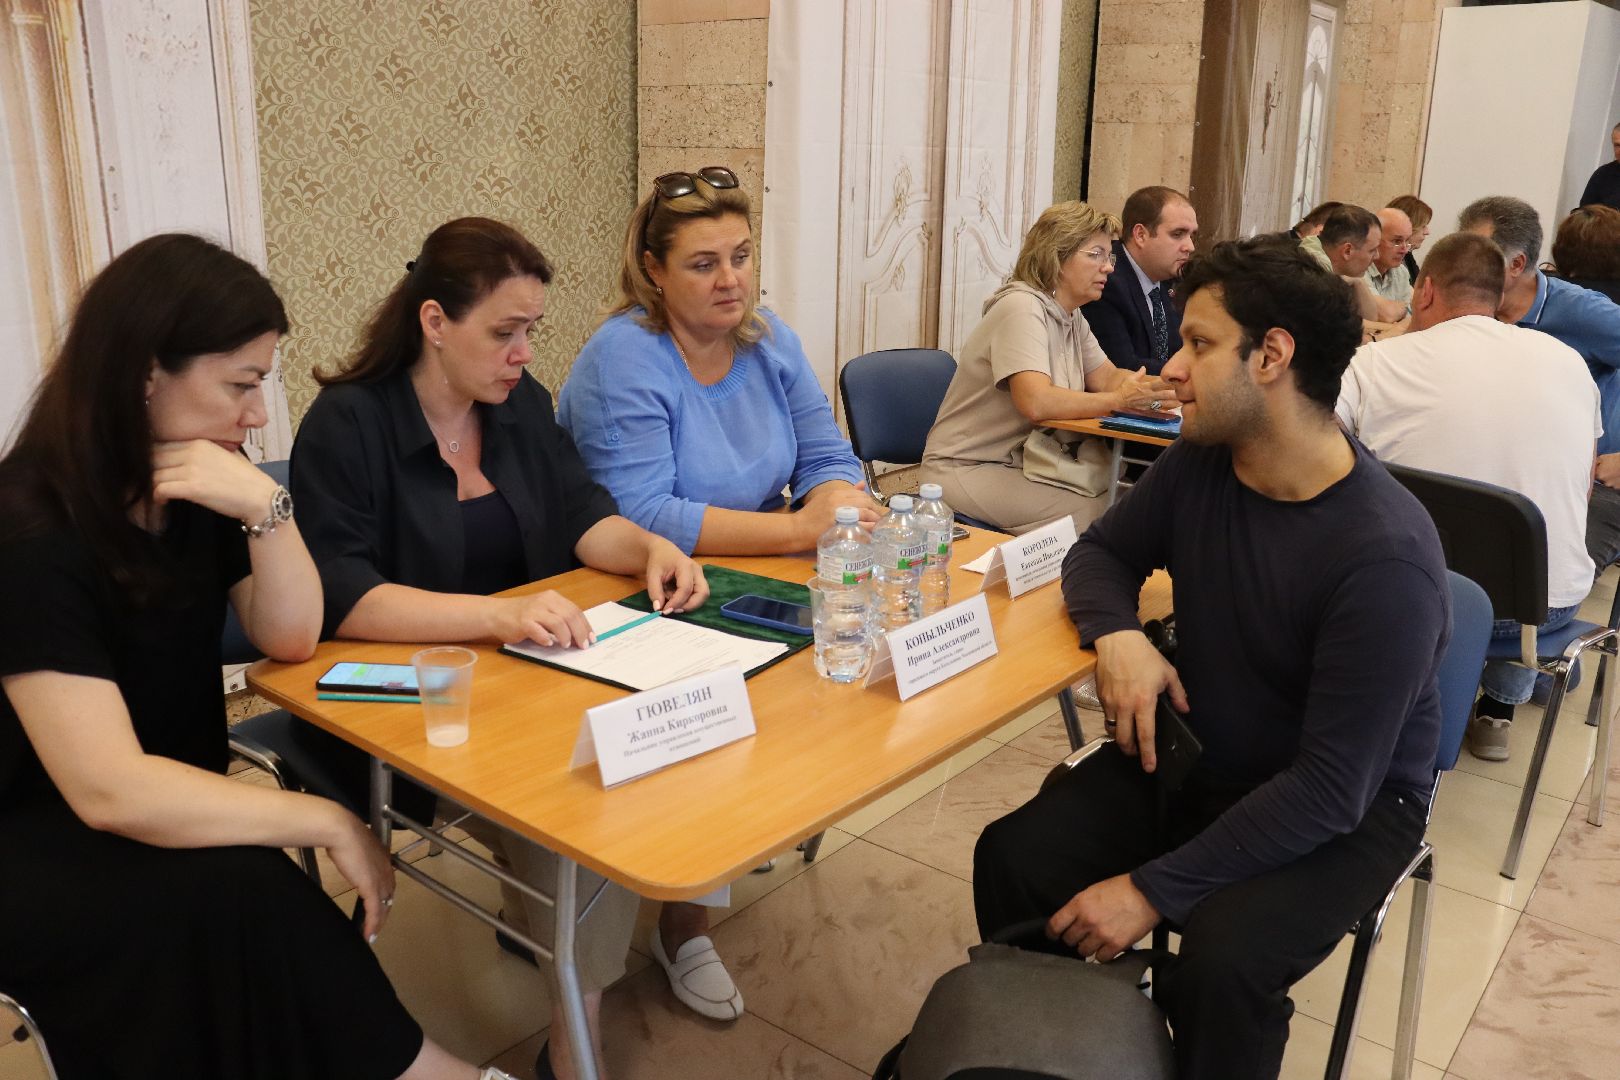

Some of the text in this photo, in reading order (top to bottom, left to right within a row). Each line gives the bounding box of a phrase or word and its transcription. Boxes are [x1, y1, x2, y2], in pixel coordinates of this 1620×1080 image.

[1022, 536, 1058, 556] КОРОЛЕВА
[905, 611, 975, 651] КОПЫЛЬЧЕНКО
[907, 651, 932, 667] Ирина
[933, 627, 980, 655] Александровна
[636, 686, 713, 721] ГЮВЕЛЯН
[627, 705, 728, 744] Жанна Киркоровна
